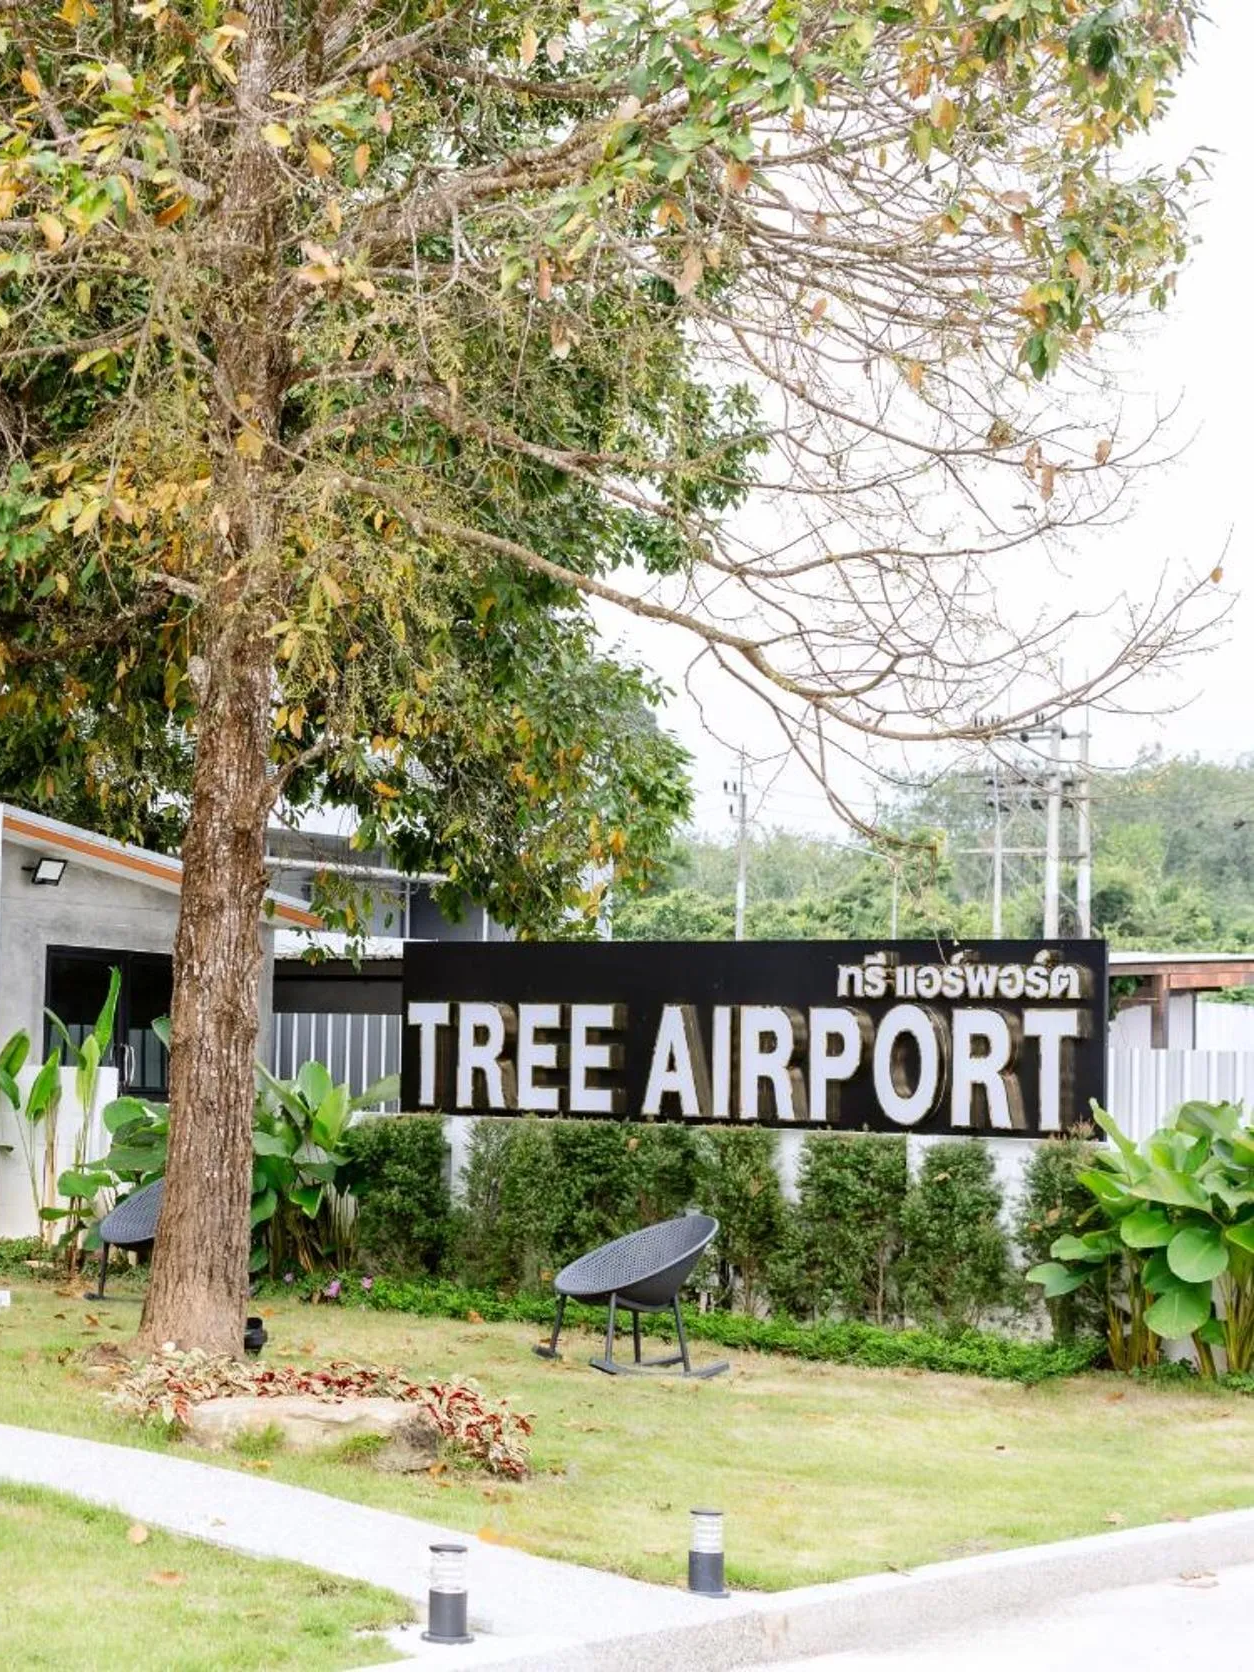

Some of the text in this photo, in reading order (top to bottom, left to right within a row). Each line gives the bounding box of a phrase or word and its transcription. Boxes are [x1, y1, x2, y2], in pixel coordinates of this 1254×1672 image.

[837, 950, 1081, 999] ทรี แอร์พอร์ต
[407, 1002, 1079, 1131] TREE AIRPORT
